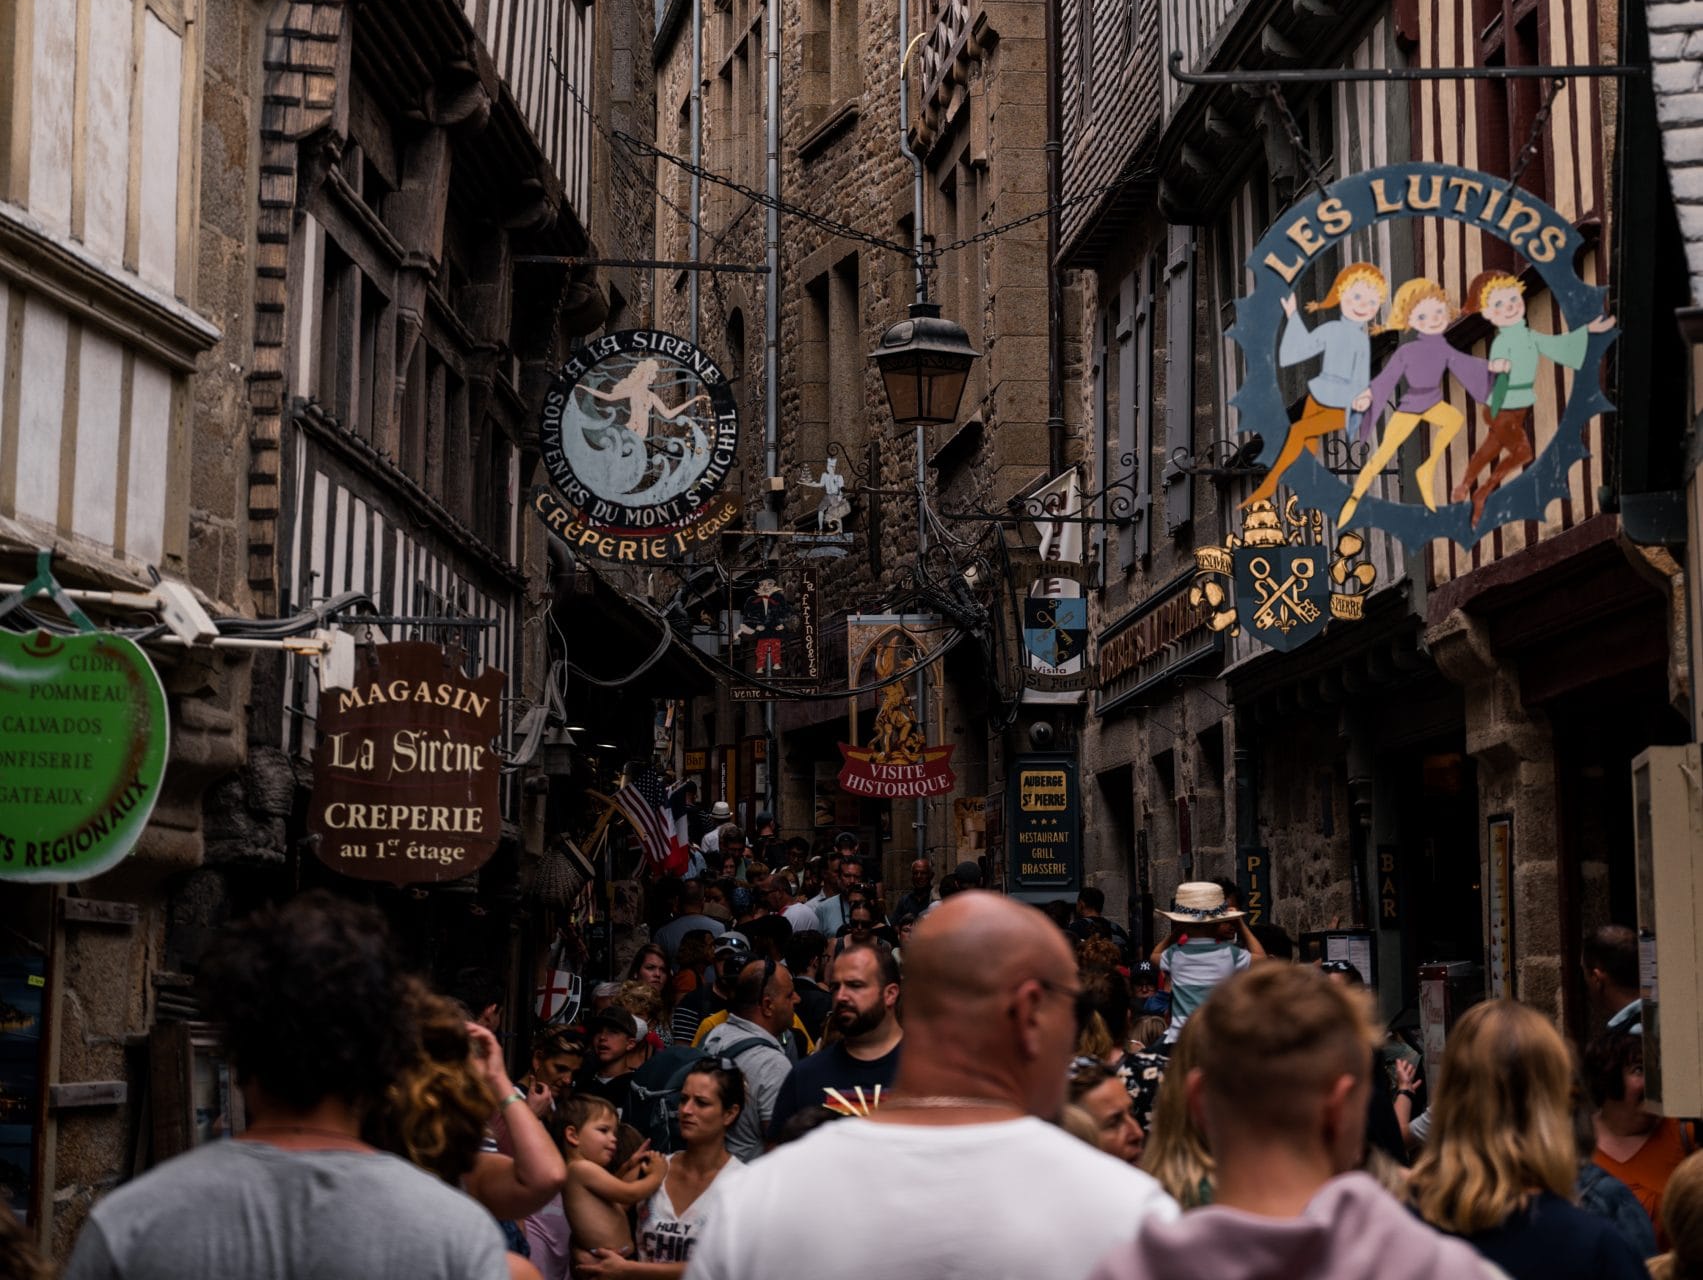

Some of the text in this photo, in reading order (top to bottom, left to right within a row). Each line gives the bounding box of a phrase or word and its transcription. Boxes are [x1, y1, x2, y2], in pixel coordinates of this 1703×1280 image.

[1263, 174, 1567, 284] LES LUTINS
[544, 391, 590, 506] SOUVENIRS
[592, 500, 619, 522] DU
[625, 498, 682, 526] MONT
[700, 408, 737, 490] MICHEL
[29, 684, 128, 702] POMMEAU
[338, 680, 490, 718] MAGASIN
[3, 717, 102, 735] CALVADOS
[328, 729, 485, 782] La Sirène
[870, 764, 926, 780] VISITE
[1024, 775, 1063, 788] AUBERGE
[846, 773, 950, 796] HISTORIQUE
[1034, 793, 1065, 806] PIERRE
[25, 774, 149, 867] REGIONAUX
[324, 803, 484, 833] CREPERIE
[1020, 831, 1069, 843] RESTAURANT
[340, 844, 367, 858] au
[406, 840, 466, 865] étage
[1032, 848, 1055, 859] GRILL
[1022, 864, 1066, 875] BRASSERIE
[1380, 853, 1399, 919] BAR
[656, 1222, 691, 1235] HOLY
